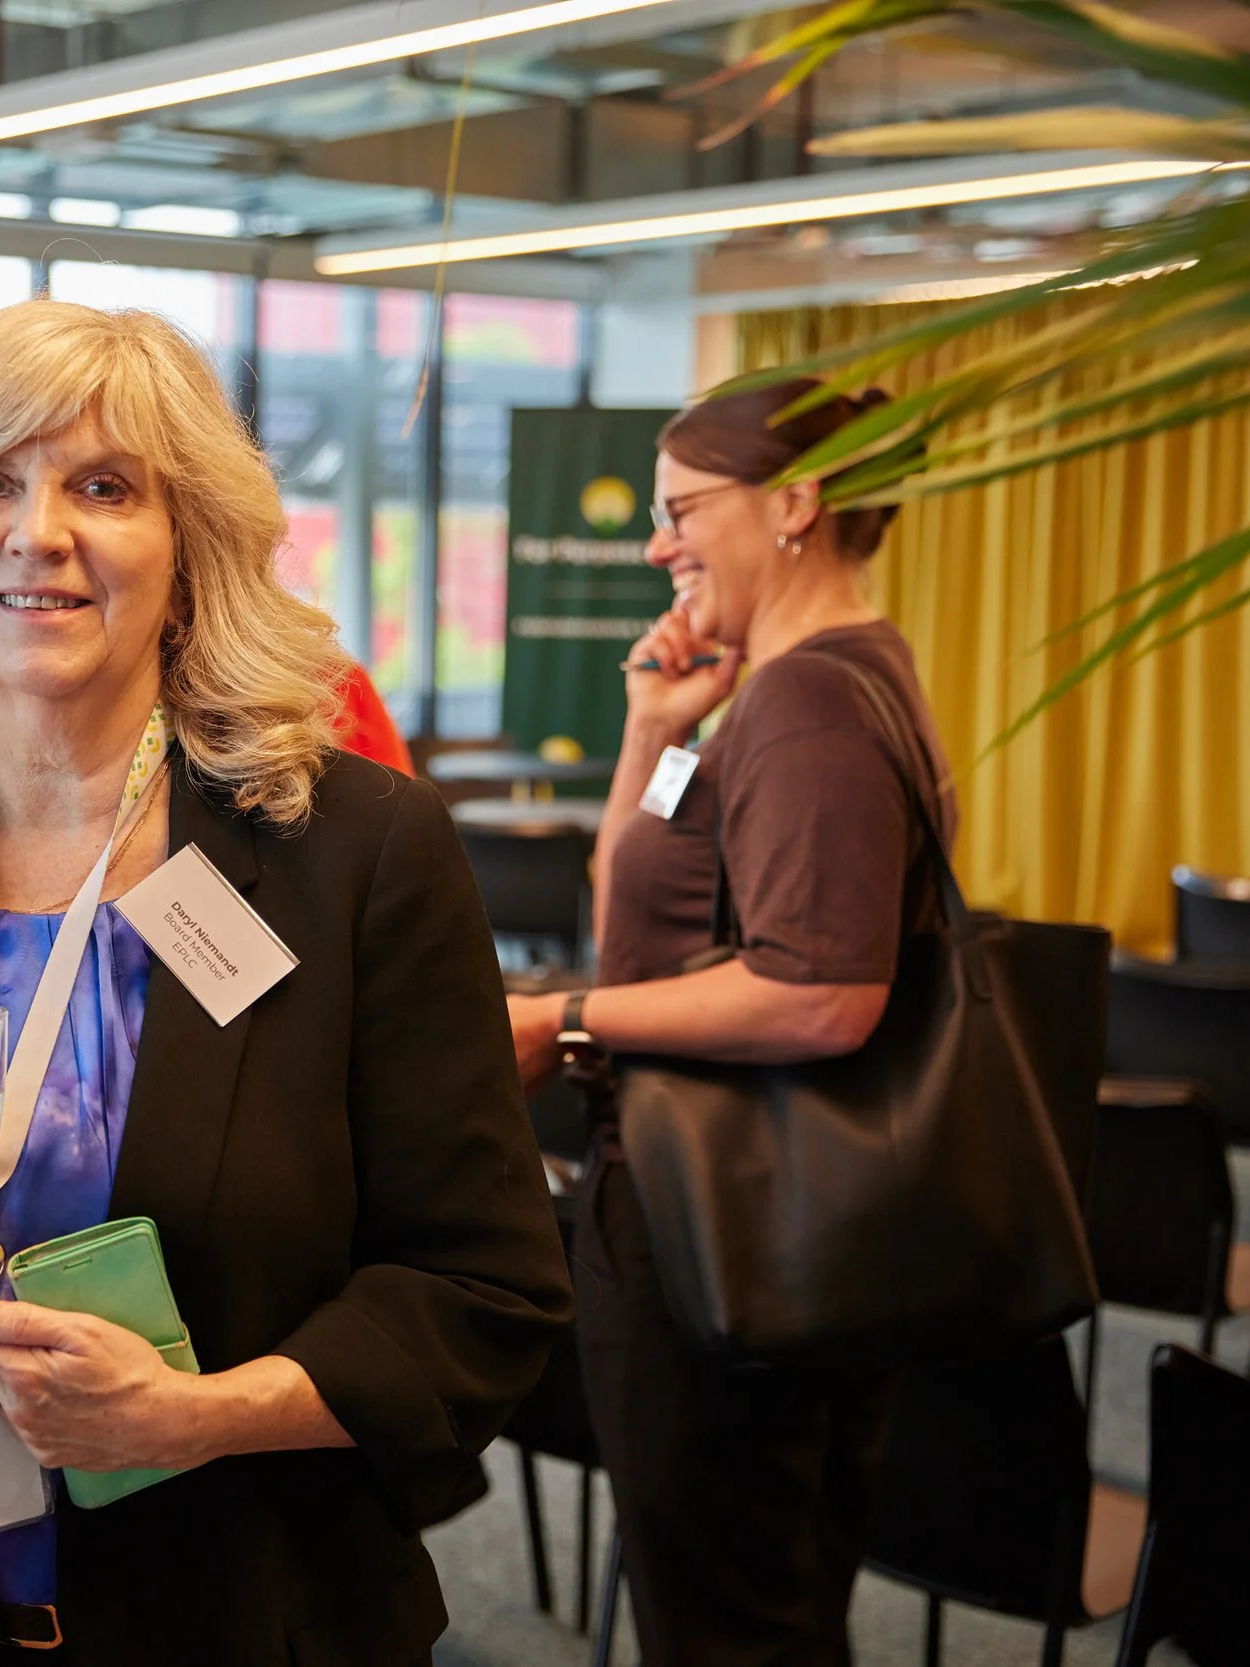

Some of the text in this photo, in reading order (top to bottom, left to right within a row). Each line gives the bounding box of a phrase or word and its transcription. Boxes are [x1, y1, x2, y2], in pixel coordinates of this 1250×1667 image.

[163, 912, 226, 981] Board Member
[171, 901, 238, 977] Daryl Niemandt
[172, 942, 198, 969] EPLC
